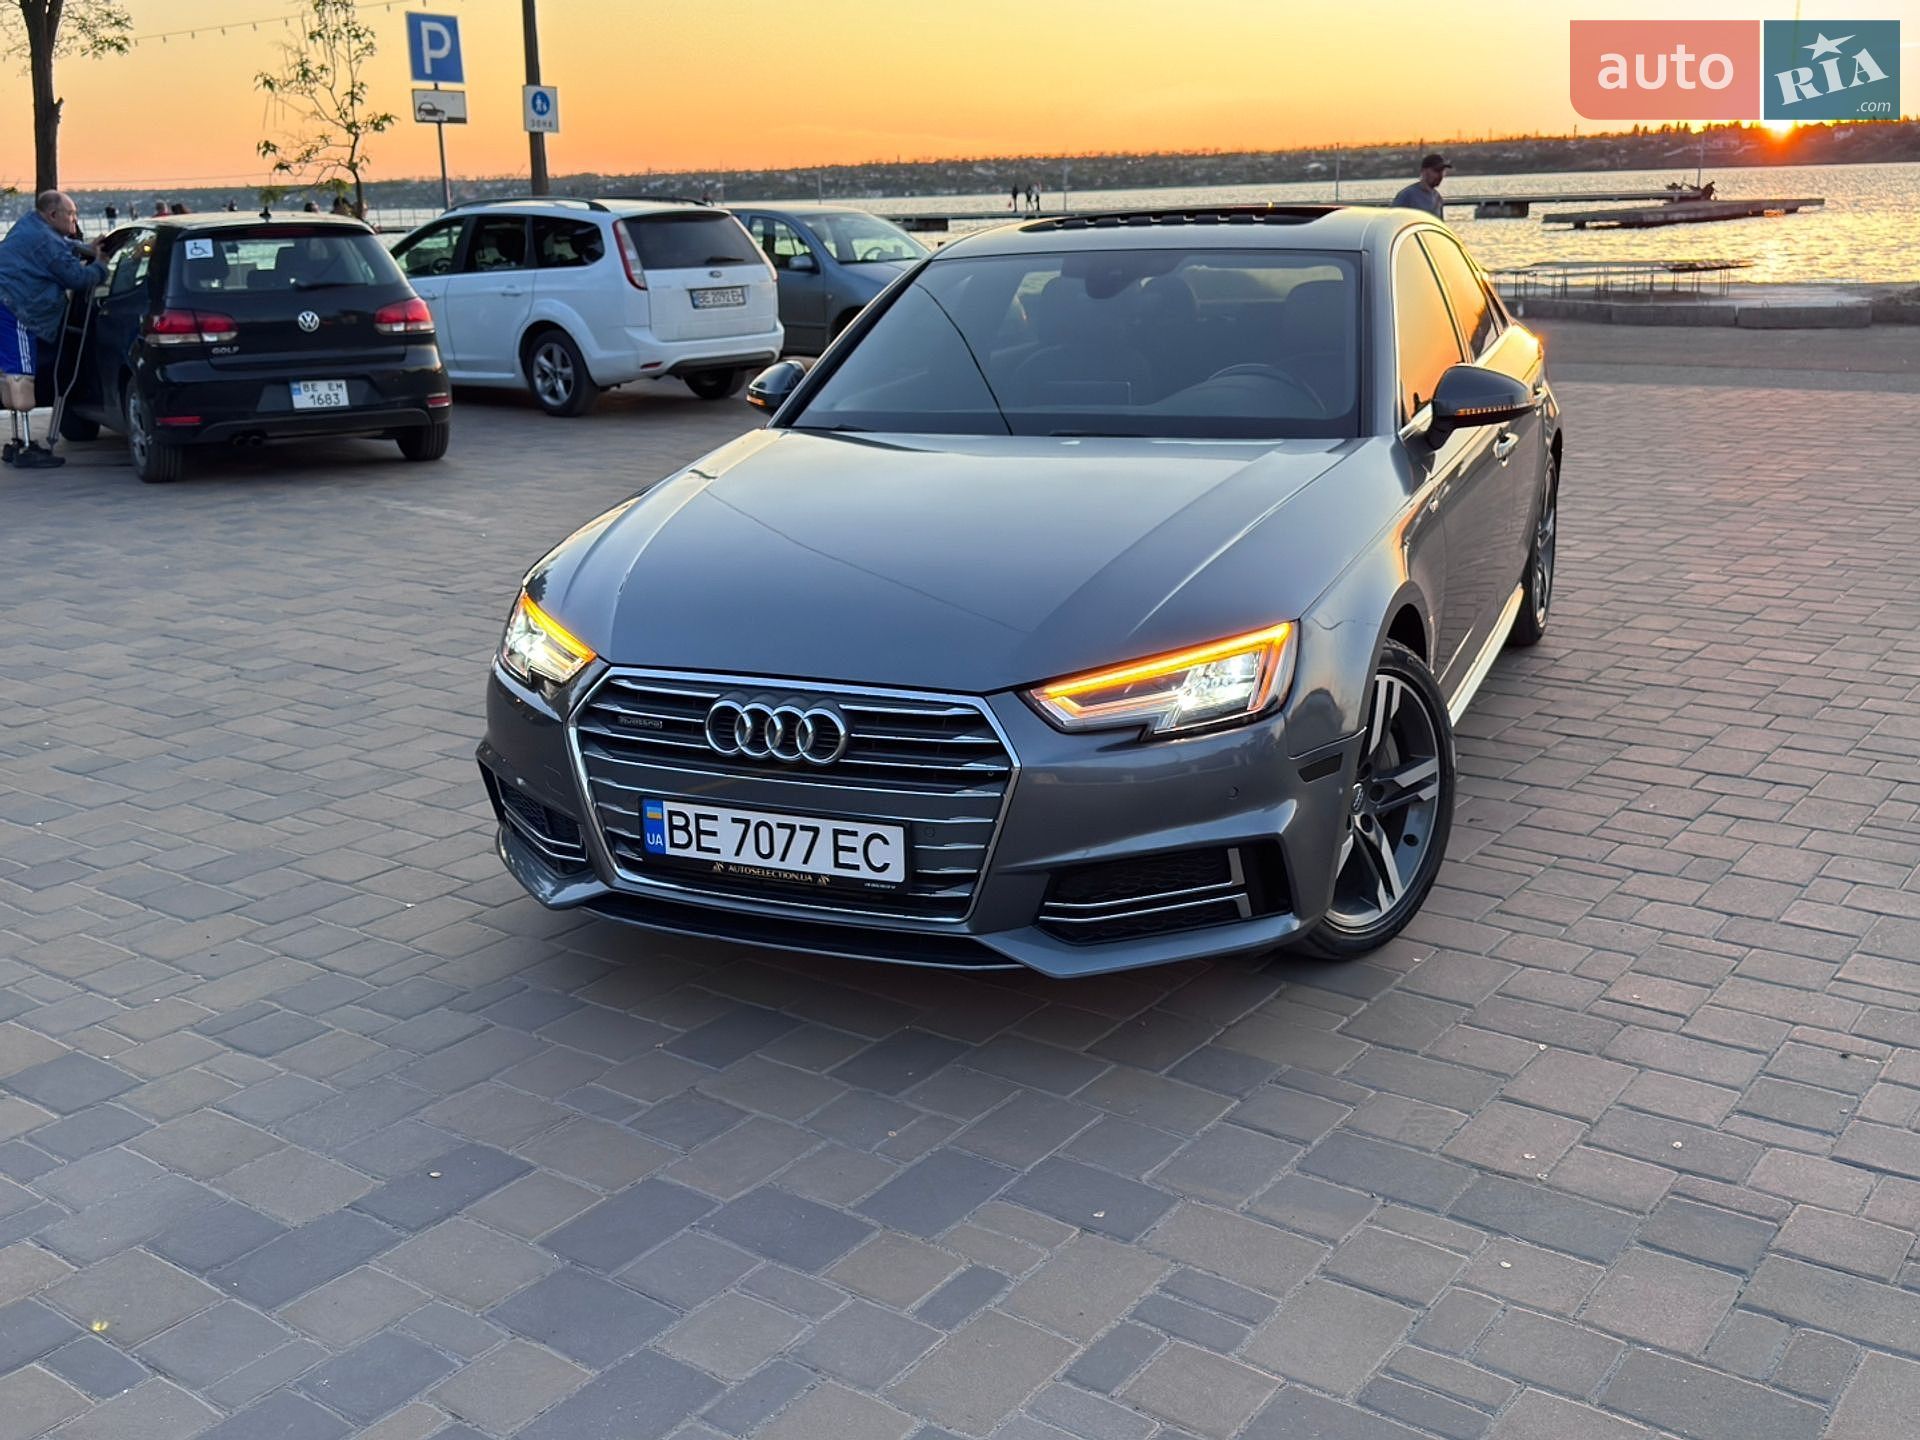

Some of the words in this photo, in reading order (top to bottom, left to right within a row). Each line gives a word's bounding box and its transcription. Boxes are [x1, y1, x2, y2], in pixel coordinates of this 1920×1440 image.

[420, 20, 452, 75] P
[212, 346, 240, 354] GOLF
[302, 383, 320, 393] BE
[310, 393, 341, 405] 1683
[646, 832, 664, 847] UA
[667, 809, 721, 854] BE
[731, 817, 820, 865] 7077
[832, 828, 891, 874] EC
